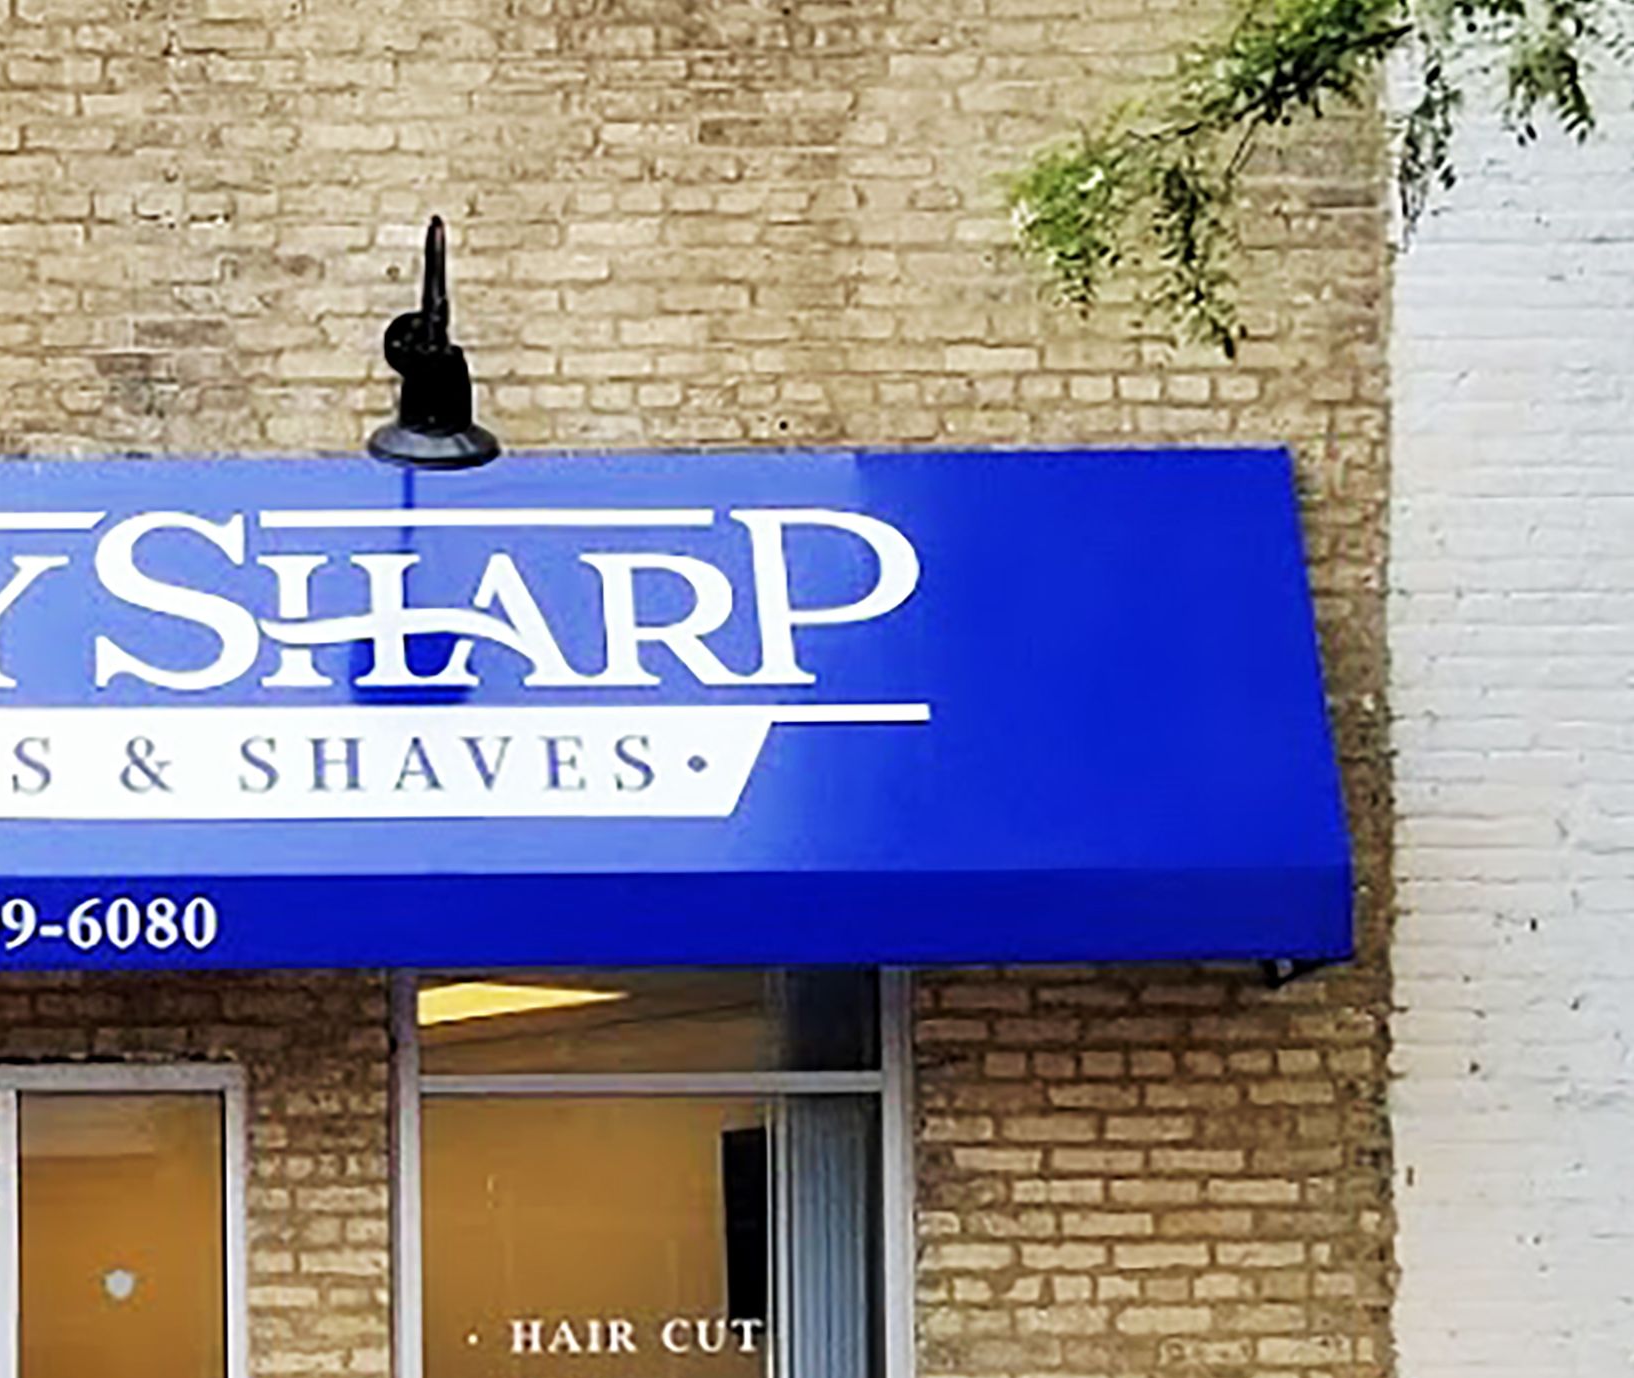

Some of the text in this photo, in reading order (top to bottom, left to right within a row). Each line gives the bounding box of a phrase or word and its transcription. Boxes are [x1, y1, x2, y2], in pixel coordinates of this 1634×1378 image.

[94, 509, 921, 692] SHARP
[118, 736, 173, 794] &
[238, 735, 656, 793] SHAVES
[510, 1318, 764, 1354] HAIR CUT
